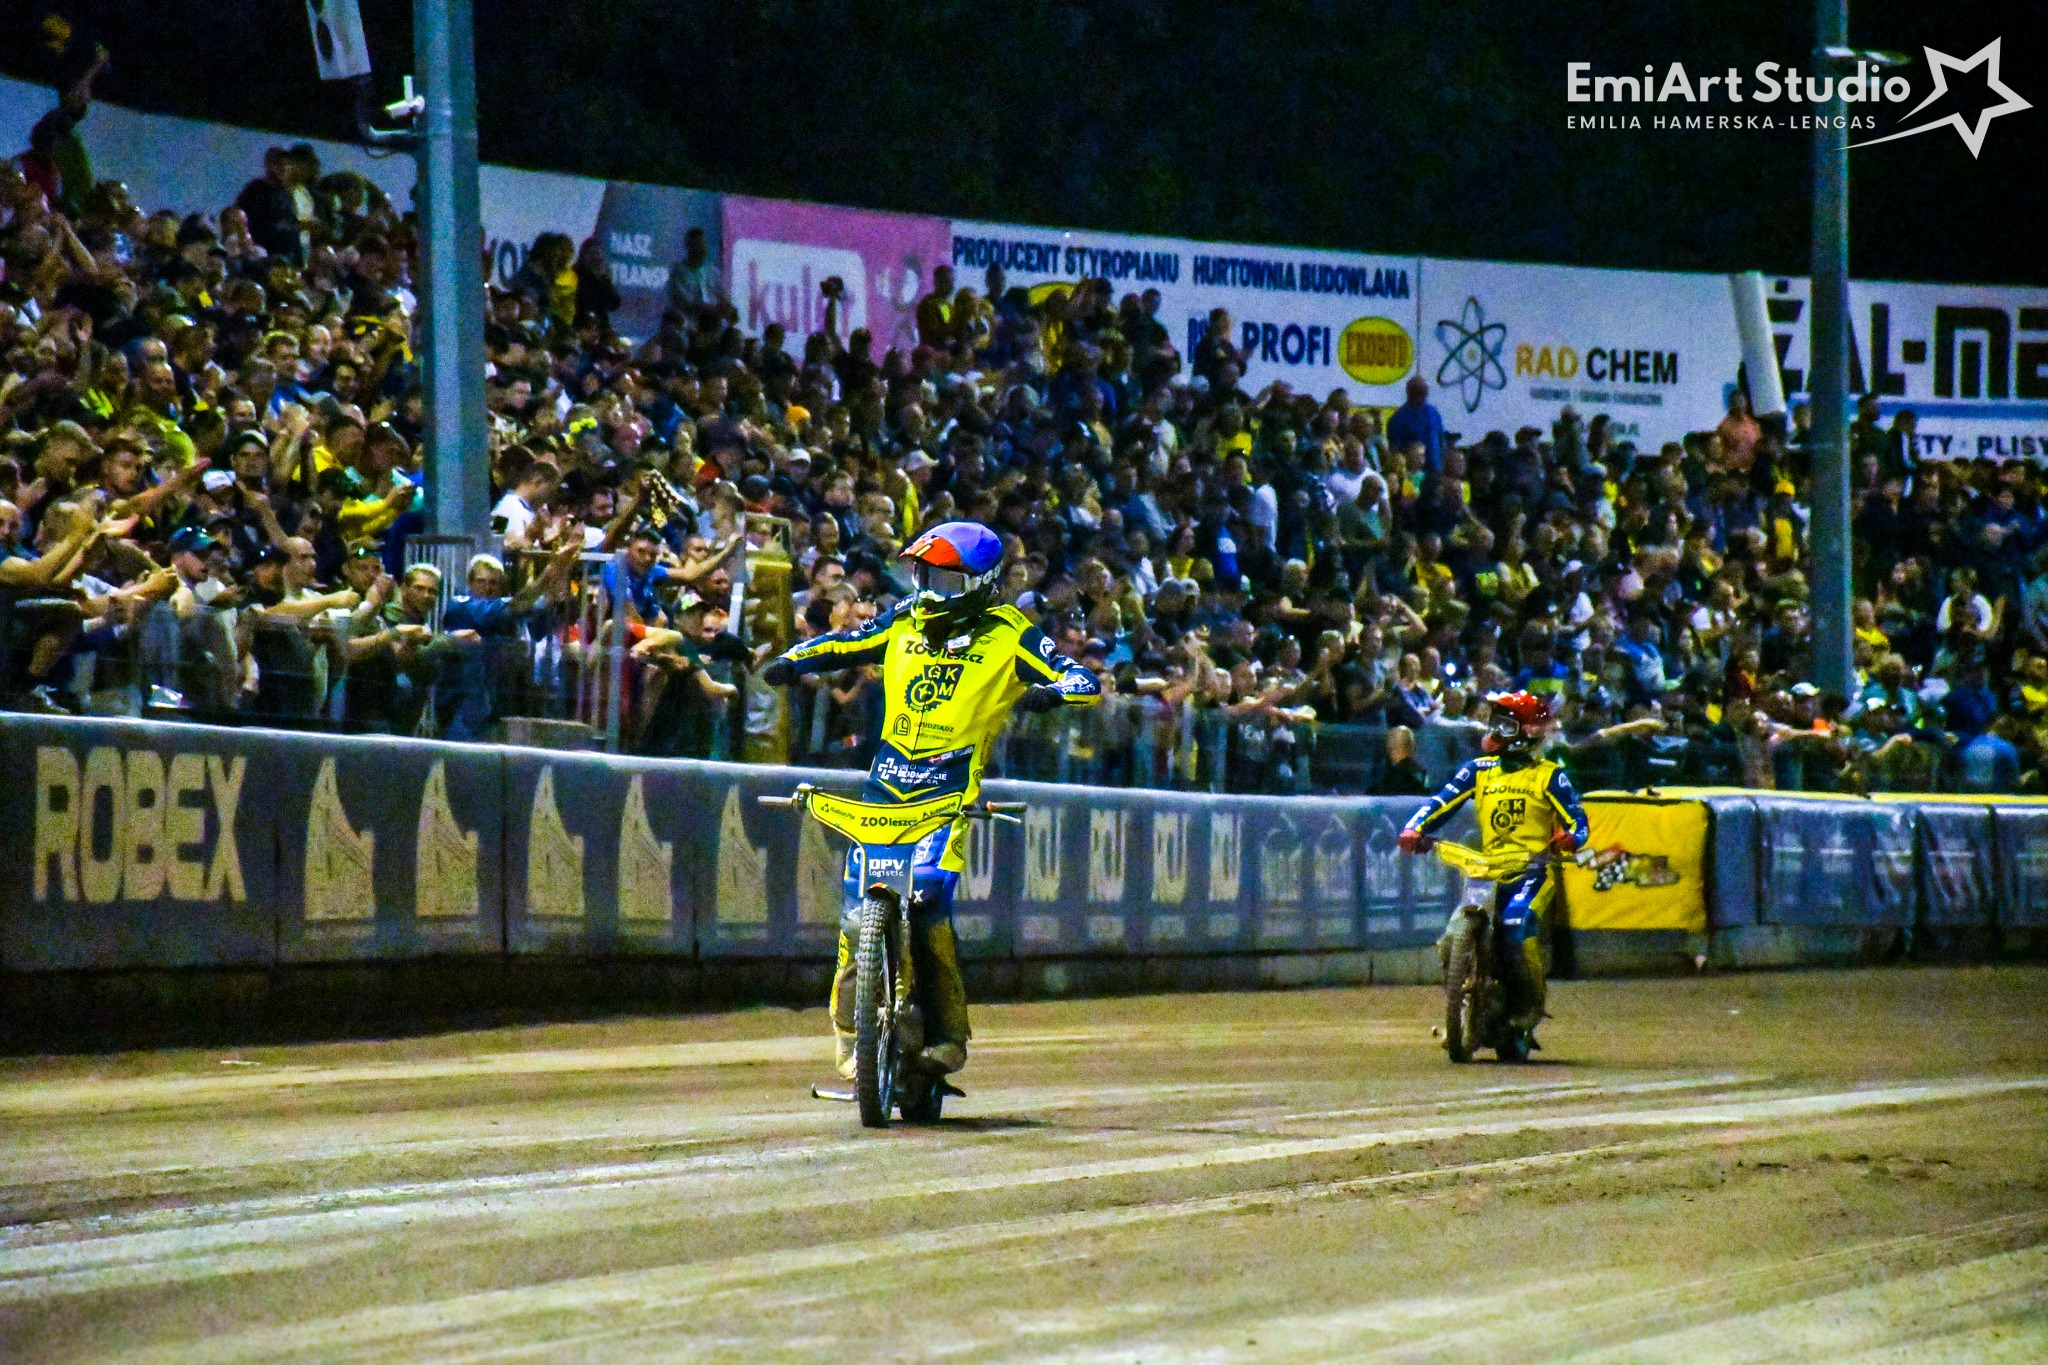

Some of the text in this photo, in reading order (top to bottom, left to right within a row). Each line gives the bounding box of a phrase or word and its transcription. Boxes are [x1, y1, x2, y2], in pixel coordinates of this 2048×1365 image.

[952, 235, 1180, 283] PRODUCENT STYROPIANU
[1192, 254, 1410, 299] HURTOWNIA BUDOWLANA
[1242, 321, 1331, 366] PROFI
[1515, 343, 1678, 384] RAD CHEM
[34, 746, 248, 903] ROBEX
[868, 858, 905, 870] DPV
[868, 869, 905, 878] logistic
